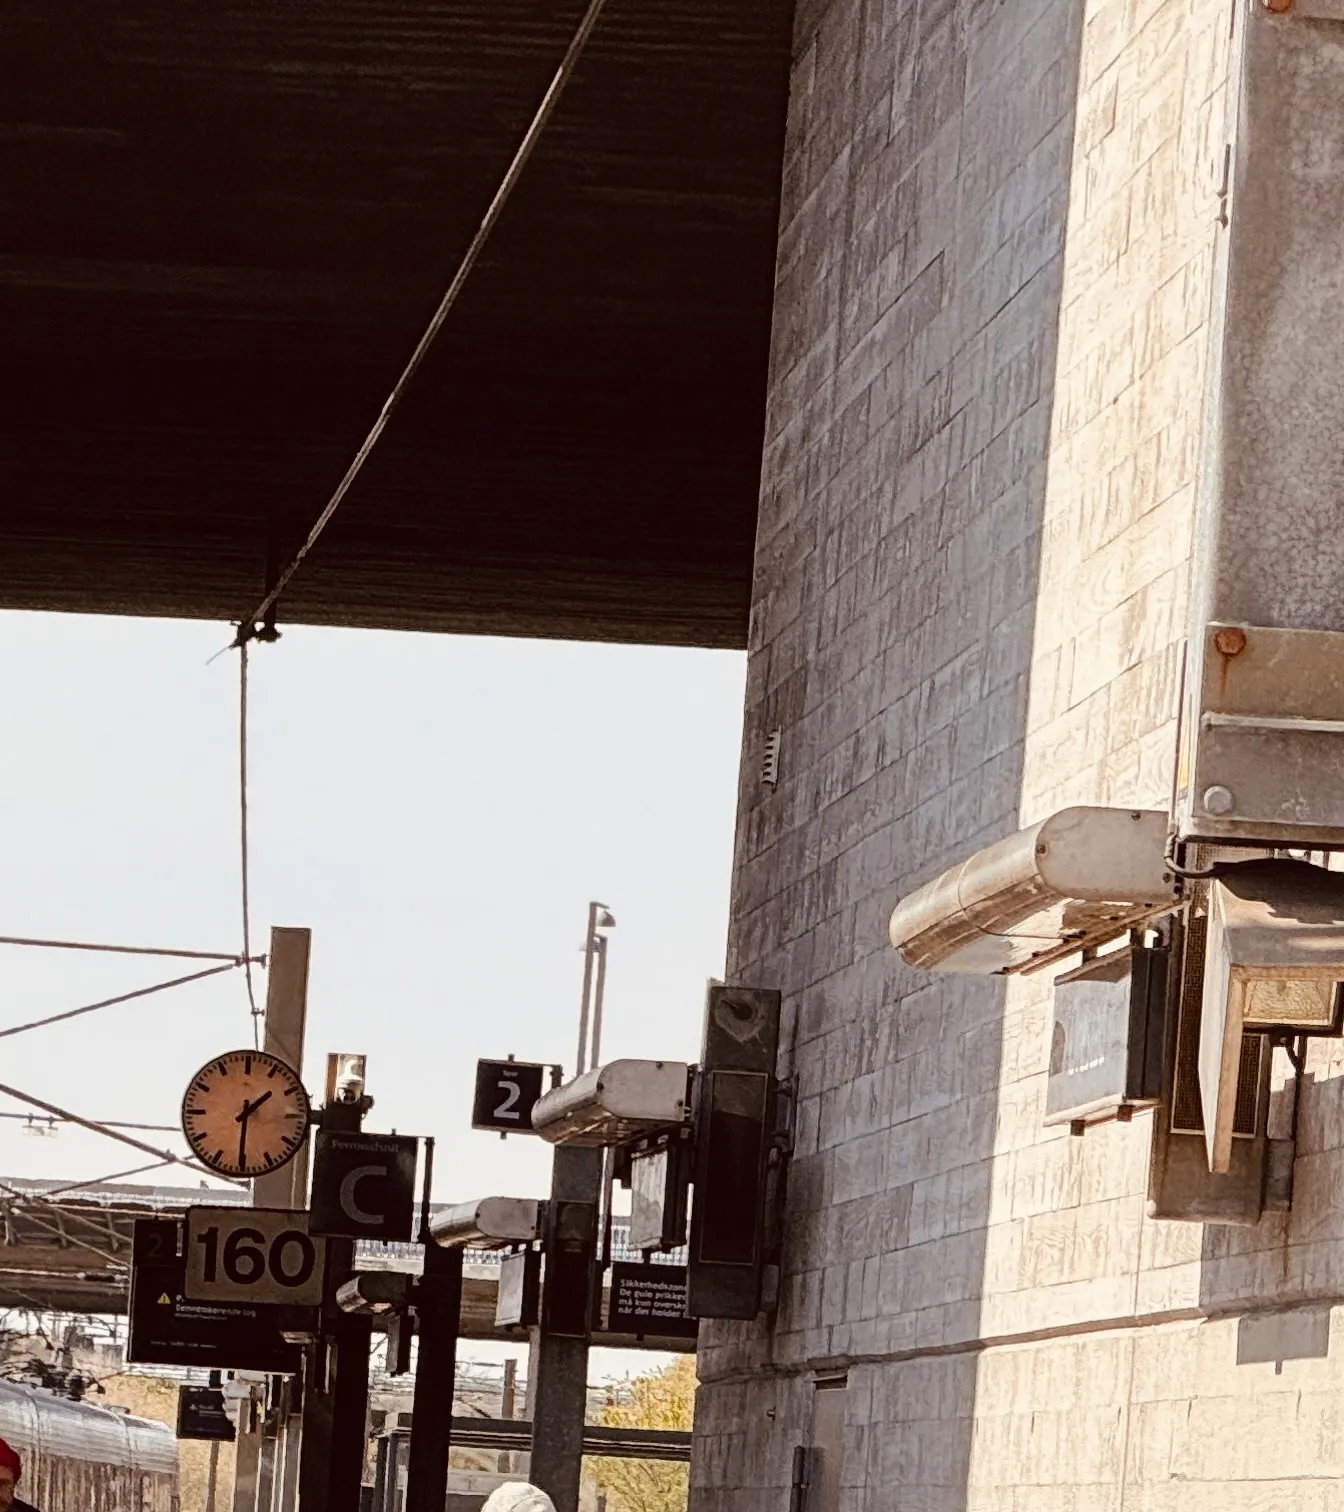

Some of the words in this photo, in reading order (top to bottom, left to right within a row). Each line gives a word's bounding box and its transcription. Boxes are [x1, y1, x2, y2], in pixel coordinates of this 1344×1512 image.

[493, 1080, 521, 1120] 2
[339, 1165, 387, 1225] C
[197, 1225, 316, 1288] 160
